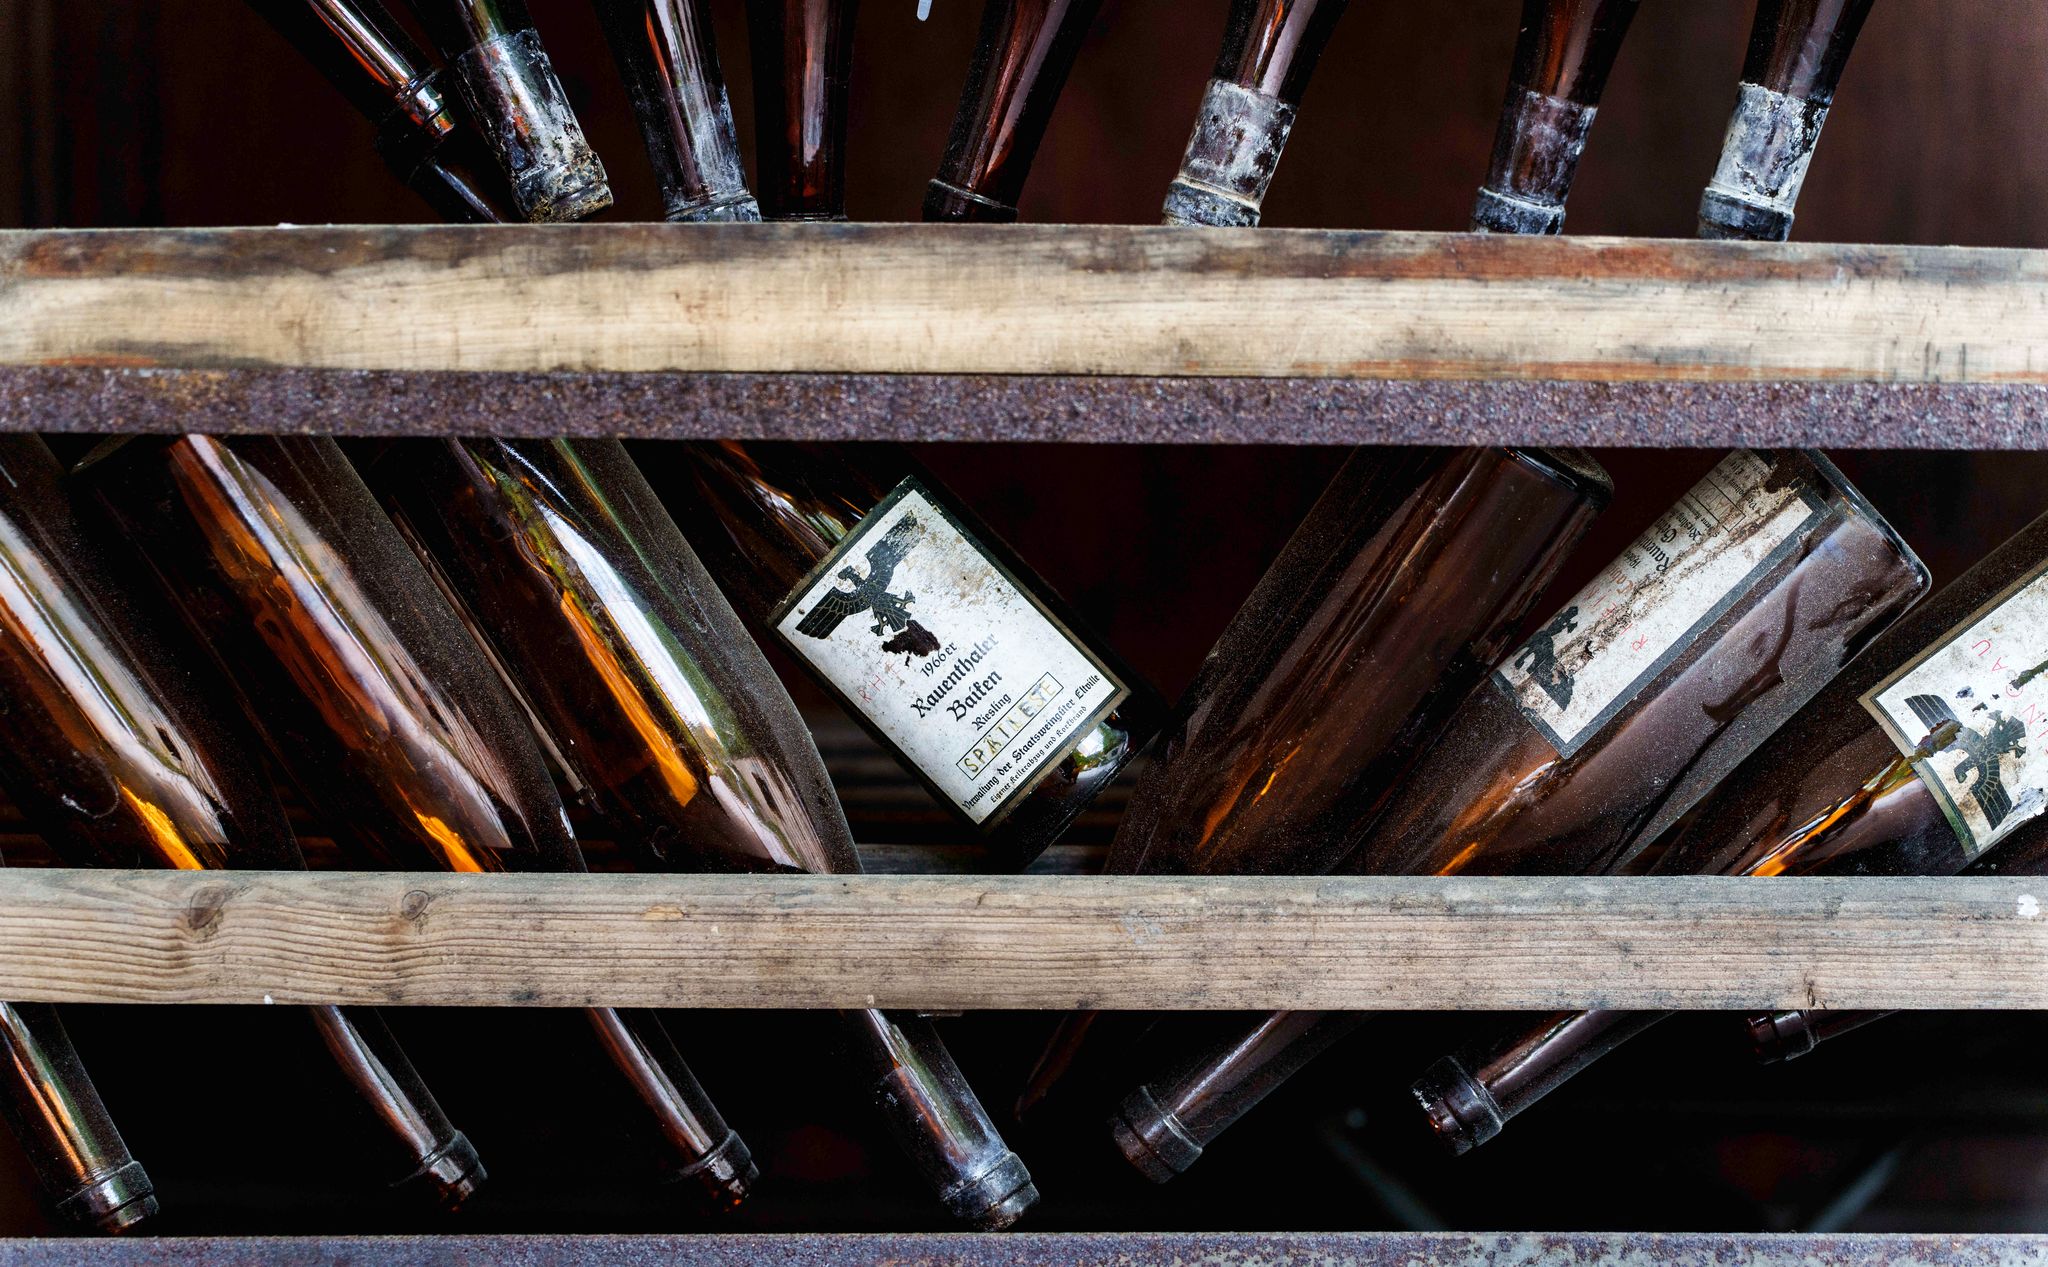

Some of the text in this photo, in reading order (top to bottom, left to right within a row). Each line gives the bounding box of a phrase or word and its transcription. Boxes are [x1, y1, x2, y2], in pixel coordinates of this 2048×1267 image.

[911, 632, 1000, 718] Rauenthaler
[920, 643, 957, 677] 1966er
[947, 671, 1002, 721] Baiken
[972, 693, 1011, 731] Riesling
[961, 674, 1100, 811] Verwaltung der Staatsweingüter Eltville
[990, 706, 1087, 803] Eigener Kellerabzug und Korkbrand
